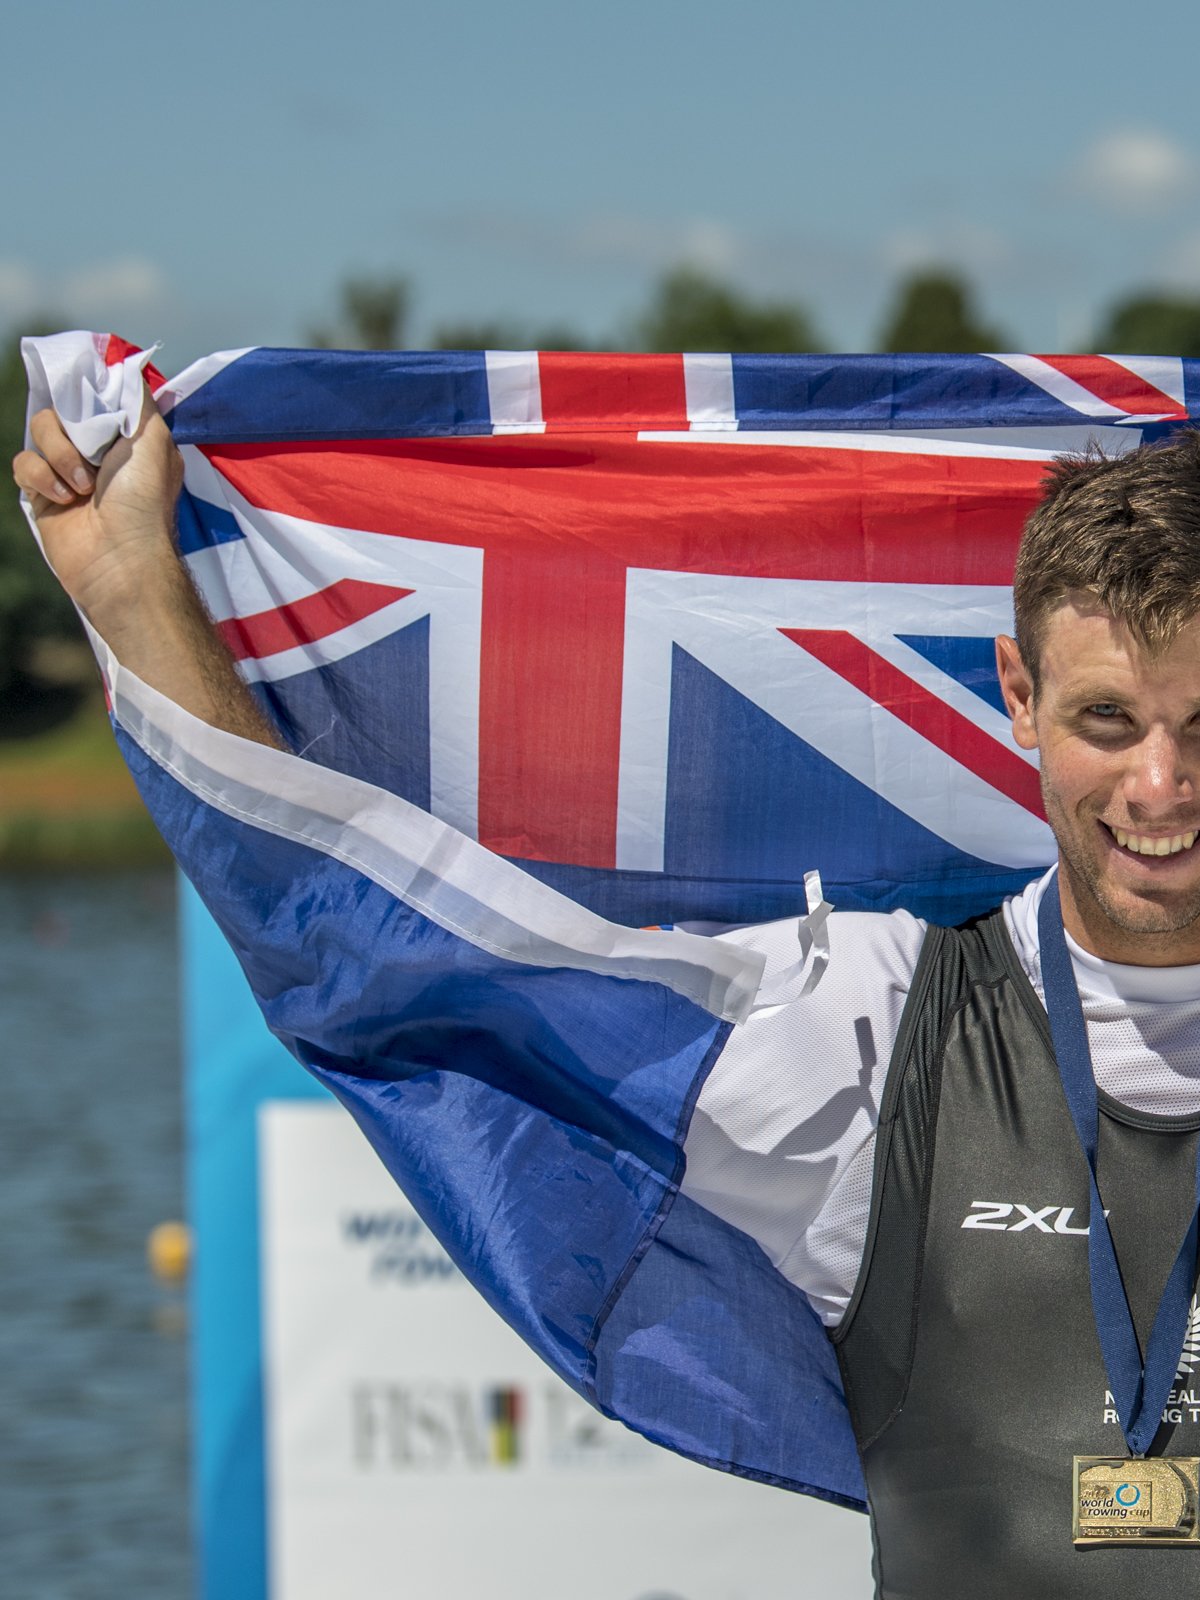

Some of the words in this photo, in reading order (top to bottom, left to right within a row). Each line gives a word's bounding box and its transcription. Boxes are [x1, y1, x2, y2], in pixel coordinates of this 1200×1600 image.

[960, 1200, 1110, 1236] 2XU
[1081, 1498, 1114, 1508] world
[1087, 1508, 1128, 1519] rowing
[1129, 1509, 1150, 1519] cup
